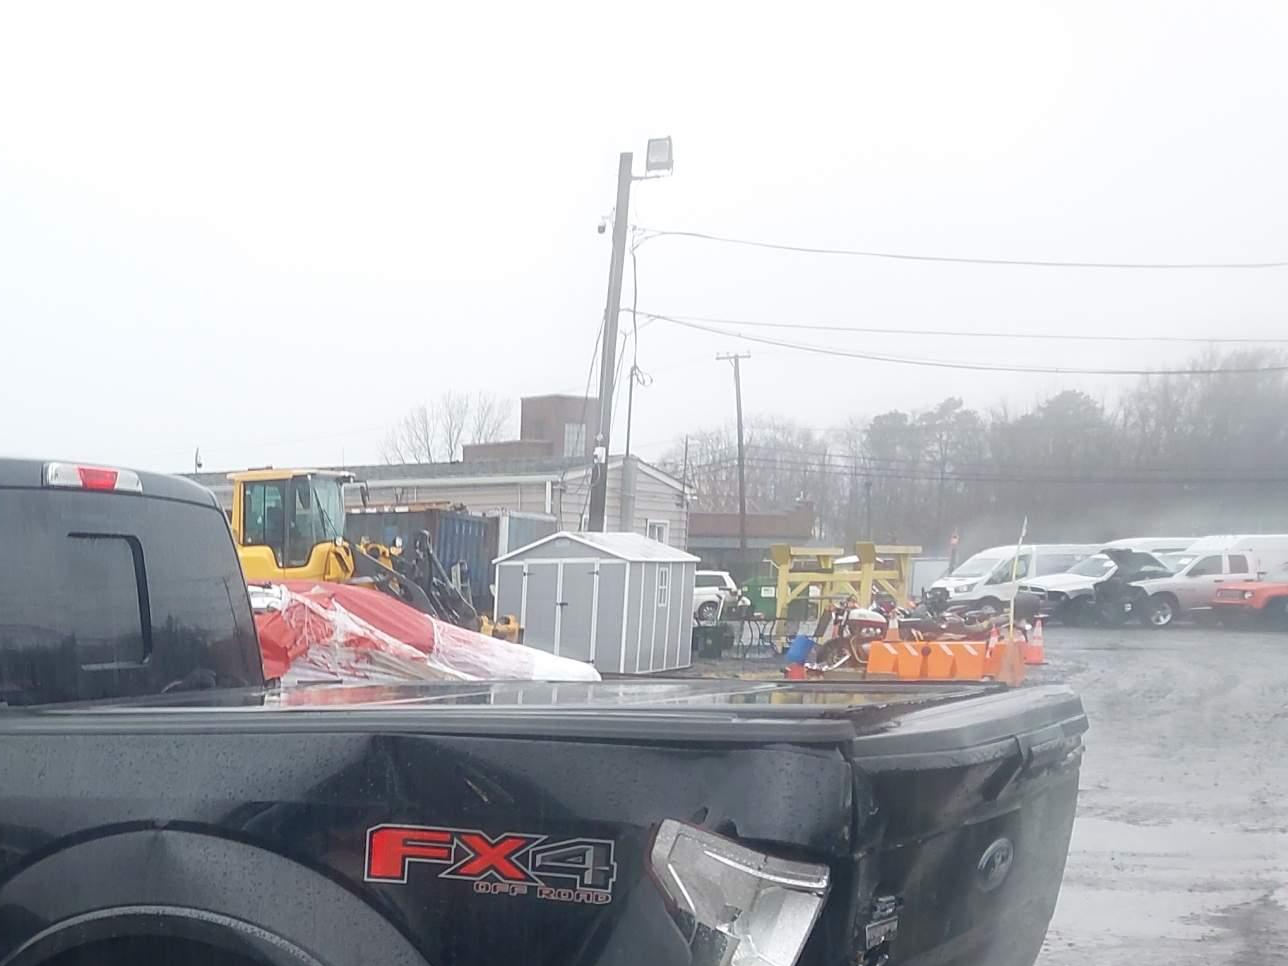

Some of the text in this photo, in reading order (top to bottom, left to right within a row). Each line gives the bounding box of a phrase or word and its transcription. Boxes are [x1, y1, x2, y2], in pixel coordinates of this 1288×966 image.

[364, 823, 617, 892] FX4
[473, 881, 613, 904] OFF ROAD
